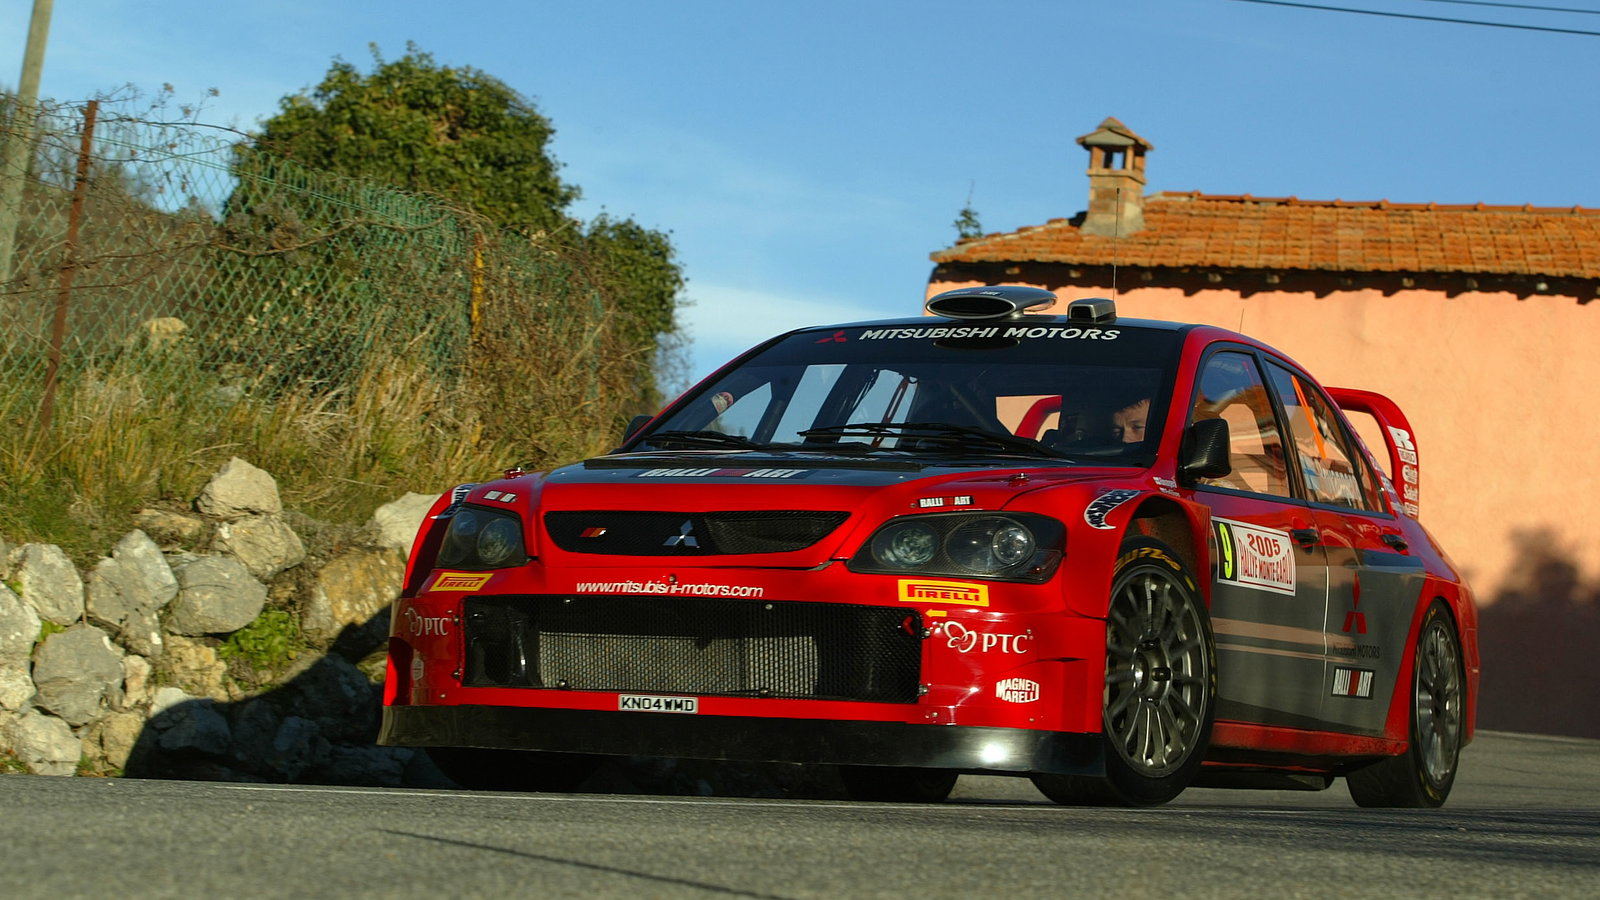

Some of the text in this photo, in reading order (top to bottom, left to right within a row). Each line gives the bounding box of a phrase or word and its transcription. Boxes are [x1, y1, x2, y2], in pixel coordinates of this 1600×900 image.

[859, 327, 1121, 340] MITSUBISHI MOTORS
[638, 468, 808, 478] RALLI ART
[919, 496, 971, 508] RALLI ART
[1219, 522, 1233, 579] 9
[1247, 533, 1280, 558] 2005
[576, 579, 763, 598] www.mitsubishi-motors.com
[907, 583, 980, 602] PIRELLI
[424, 617, 449, 636] PTC
[982, 633, 1028, 654] PTC
[996, 677, 1039, 691] MAGNETI
[1356, 671, 1373, 697] ART
[996, 690, 1039, 703] MARELLI
